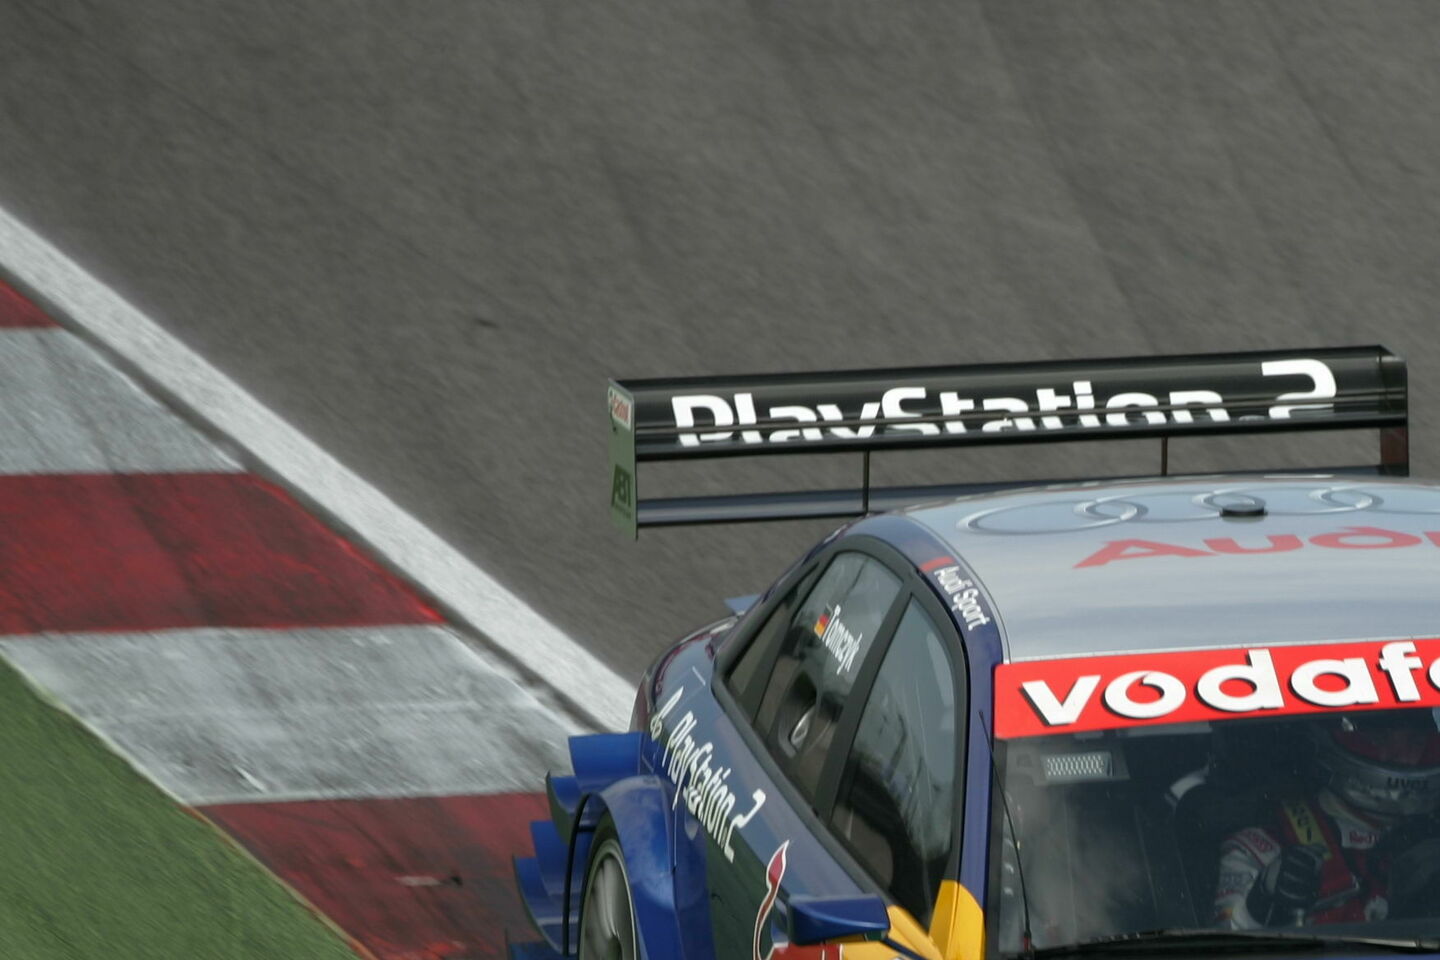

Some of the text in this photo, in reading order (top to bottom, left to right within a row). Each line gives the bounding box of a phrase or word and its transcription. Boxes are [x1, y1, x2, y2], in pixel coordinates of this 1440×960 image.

[1260, 357, 1338, 421] 2
[933, 565, 991, 631] Audi Sport
